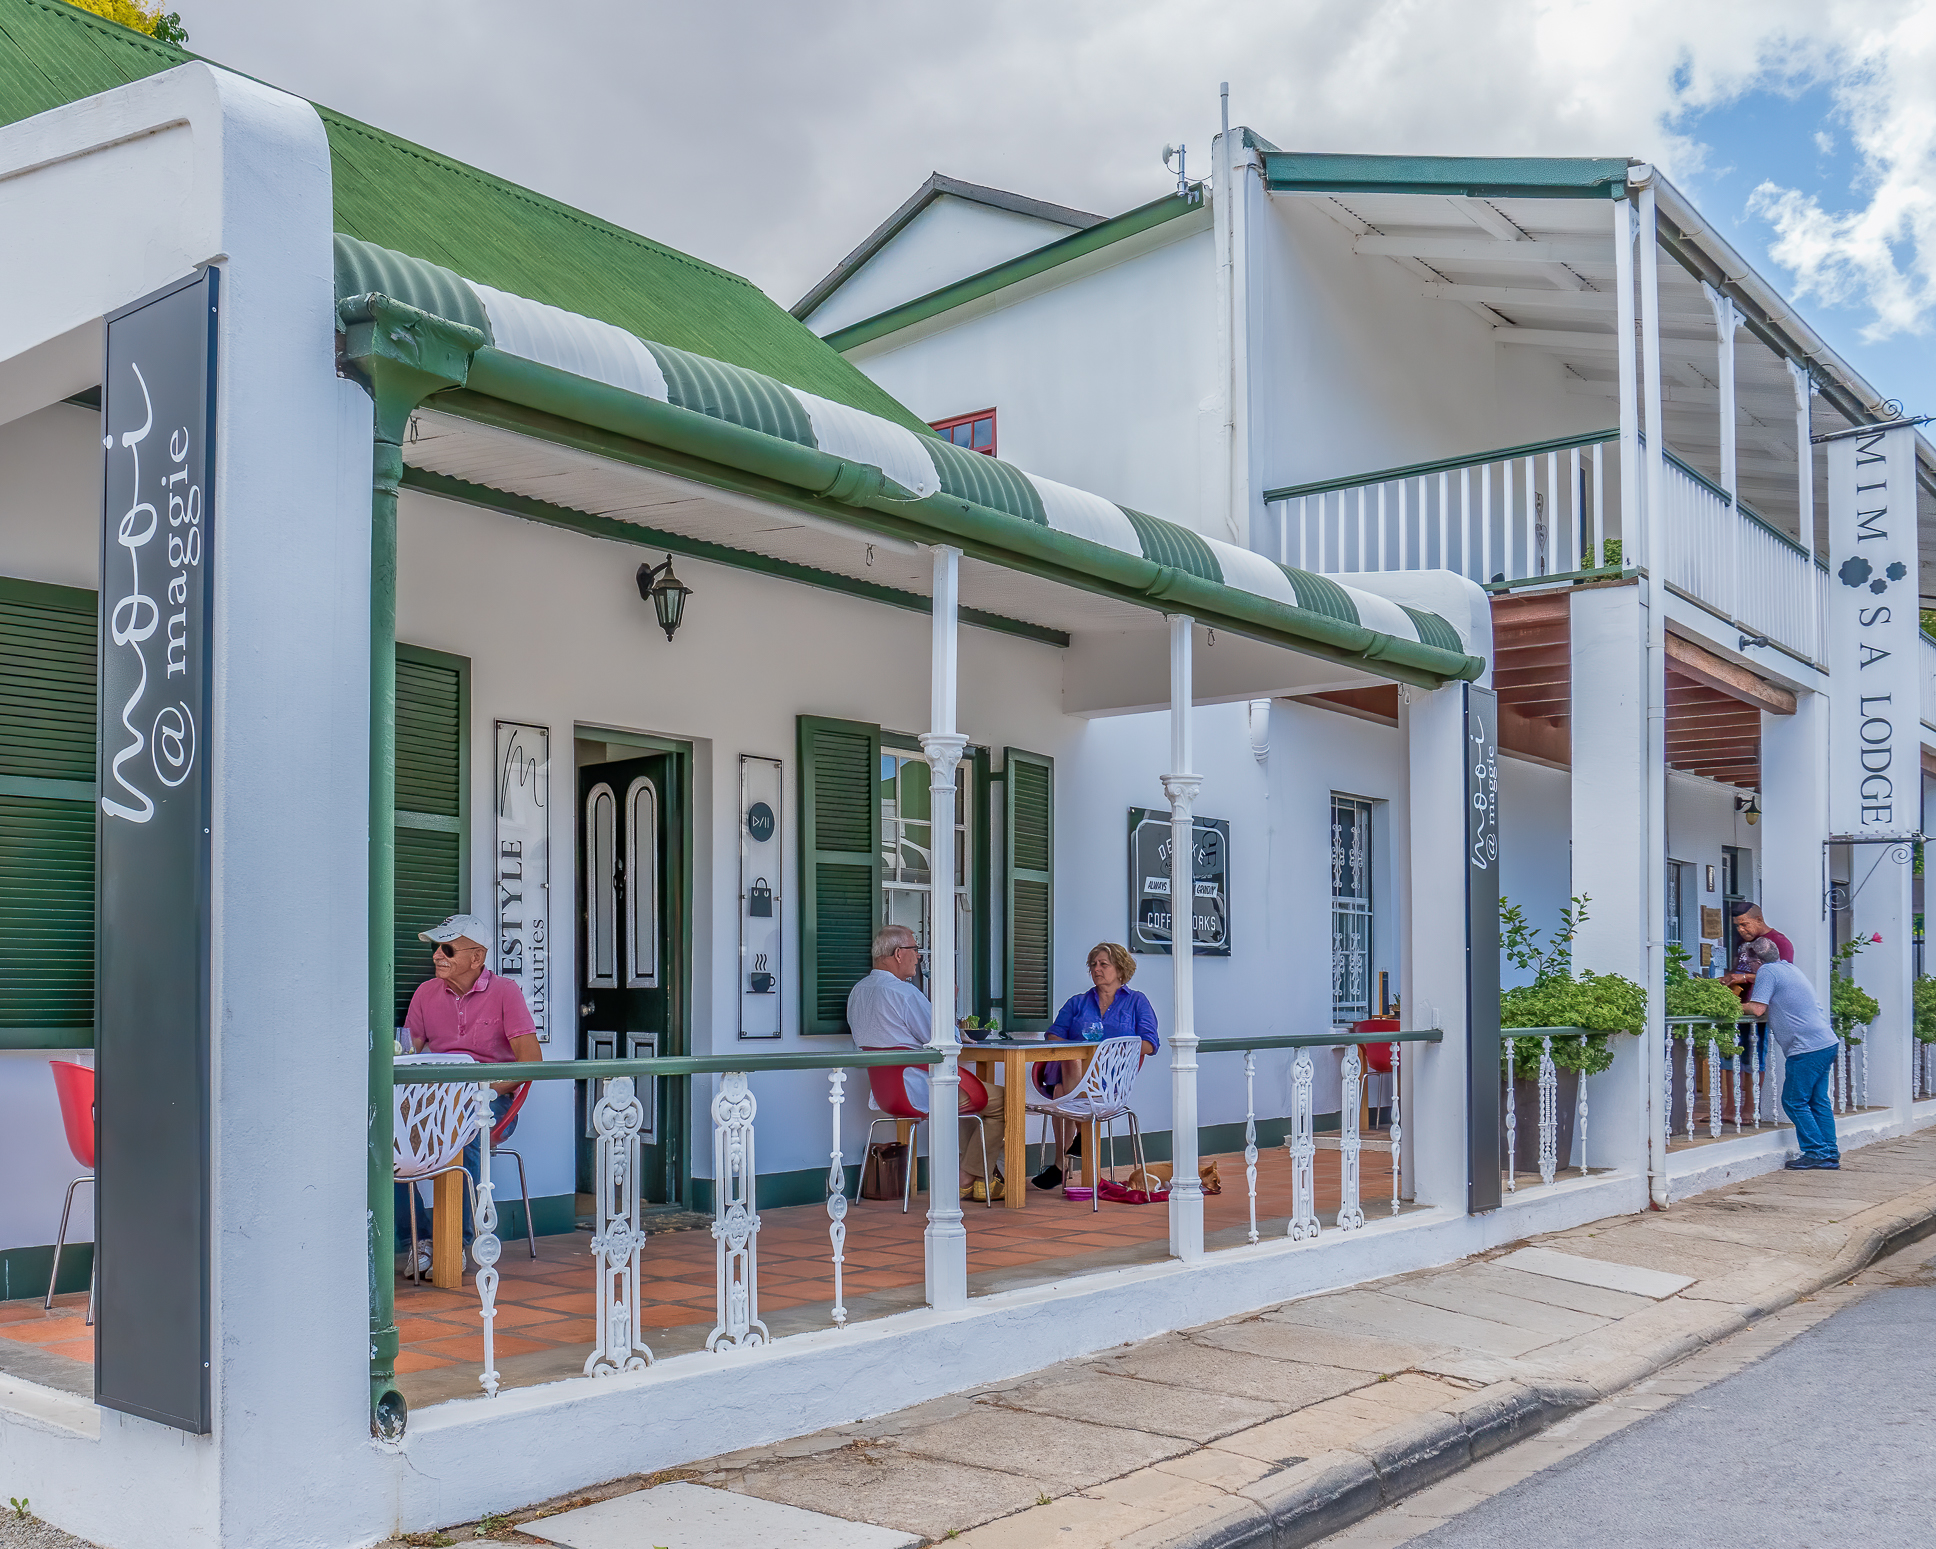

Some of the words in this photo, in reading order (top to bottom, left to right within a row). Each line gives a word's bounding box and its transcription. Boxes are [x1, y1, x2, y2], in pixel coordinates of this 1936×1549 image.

[161, 425, 201, 679] maggie
[151, 700, 195, 787] @
[1487, 745, 1498, 826] maggie
[1859, 694, 1893, 826] LODGE
[1147, 880, 1168, 891] ALWAYS
[1158, 838, 1206, 865] DEXE
[501, 840, 523, 992] ESTYLE
[1147, 912, 1216, 931] COFFORKS
[528, 918, 545, 1032] Luxuries
